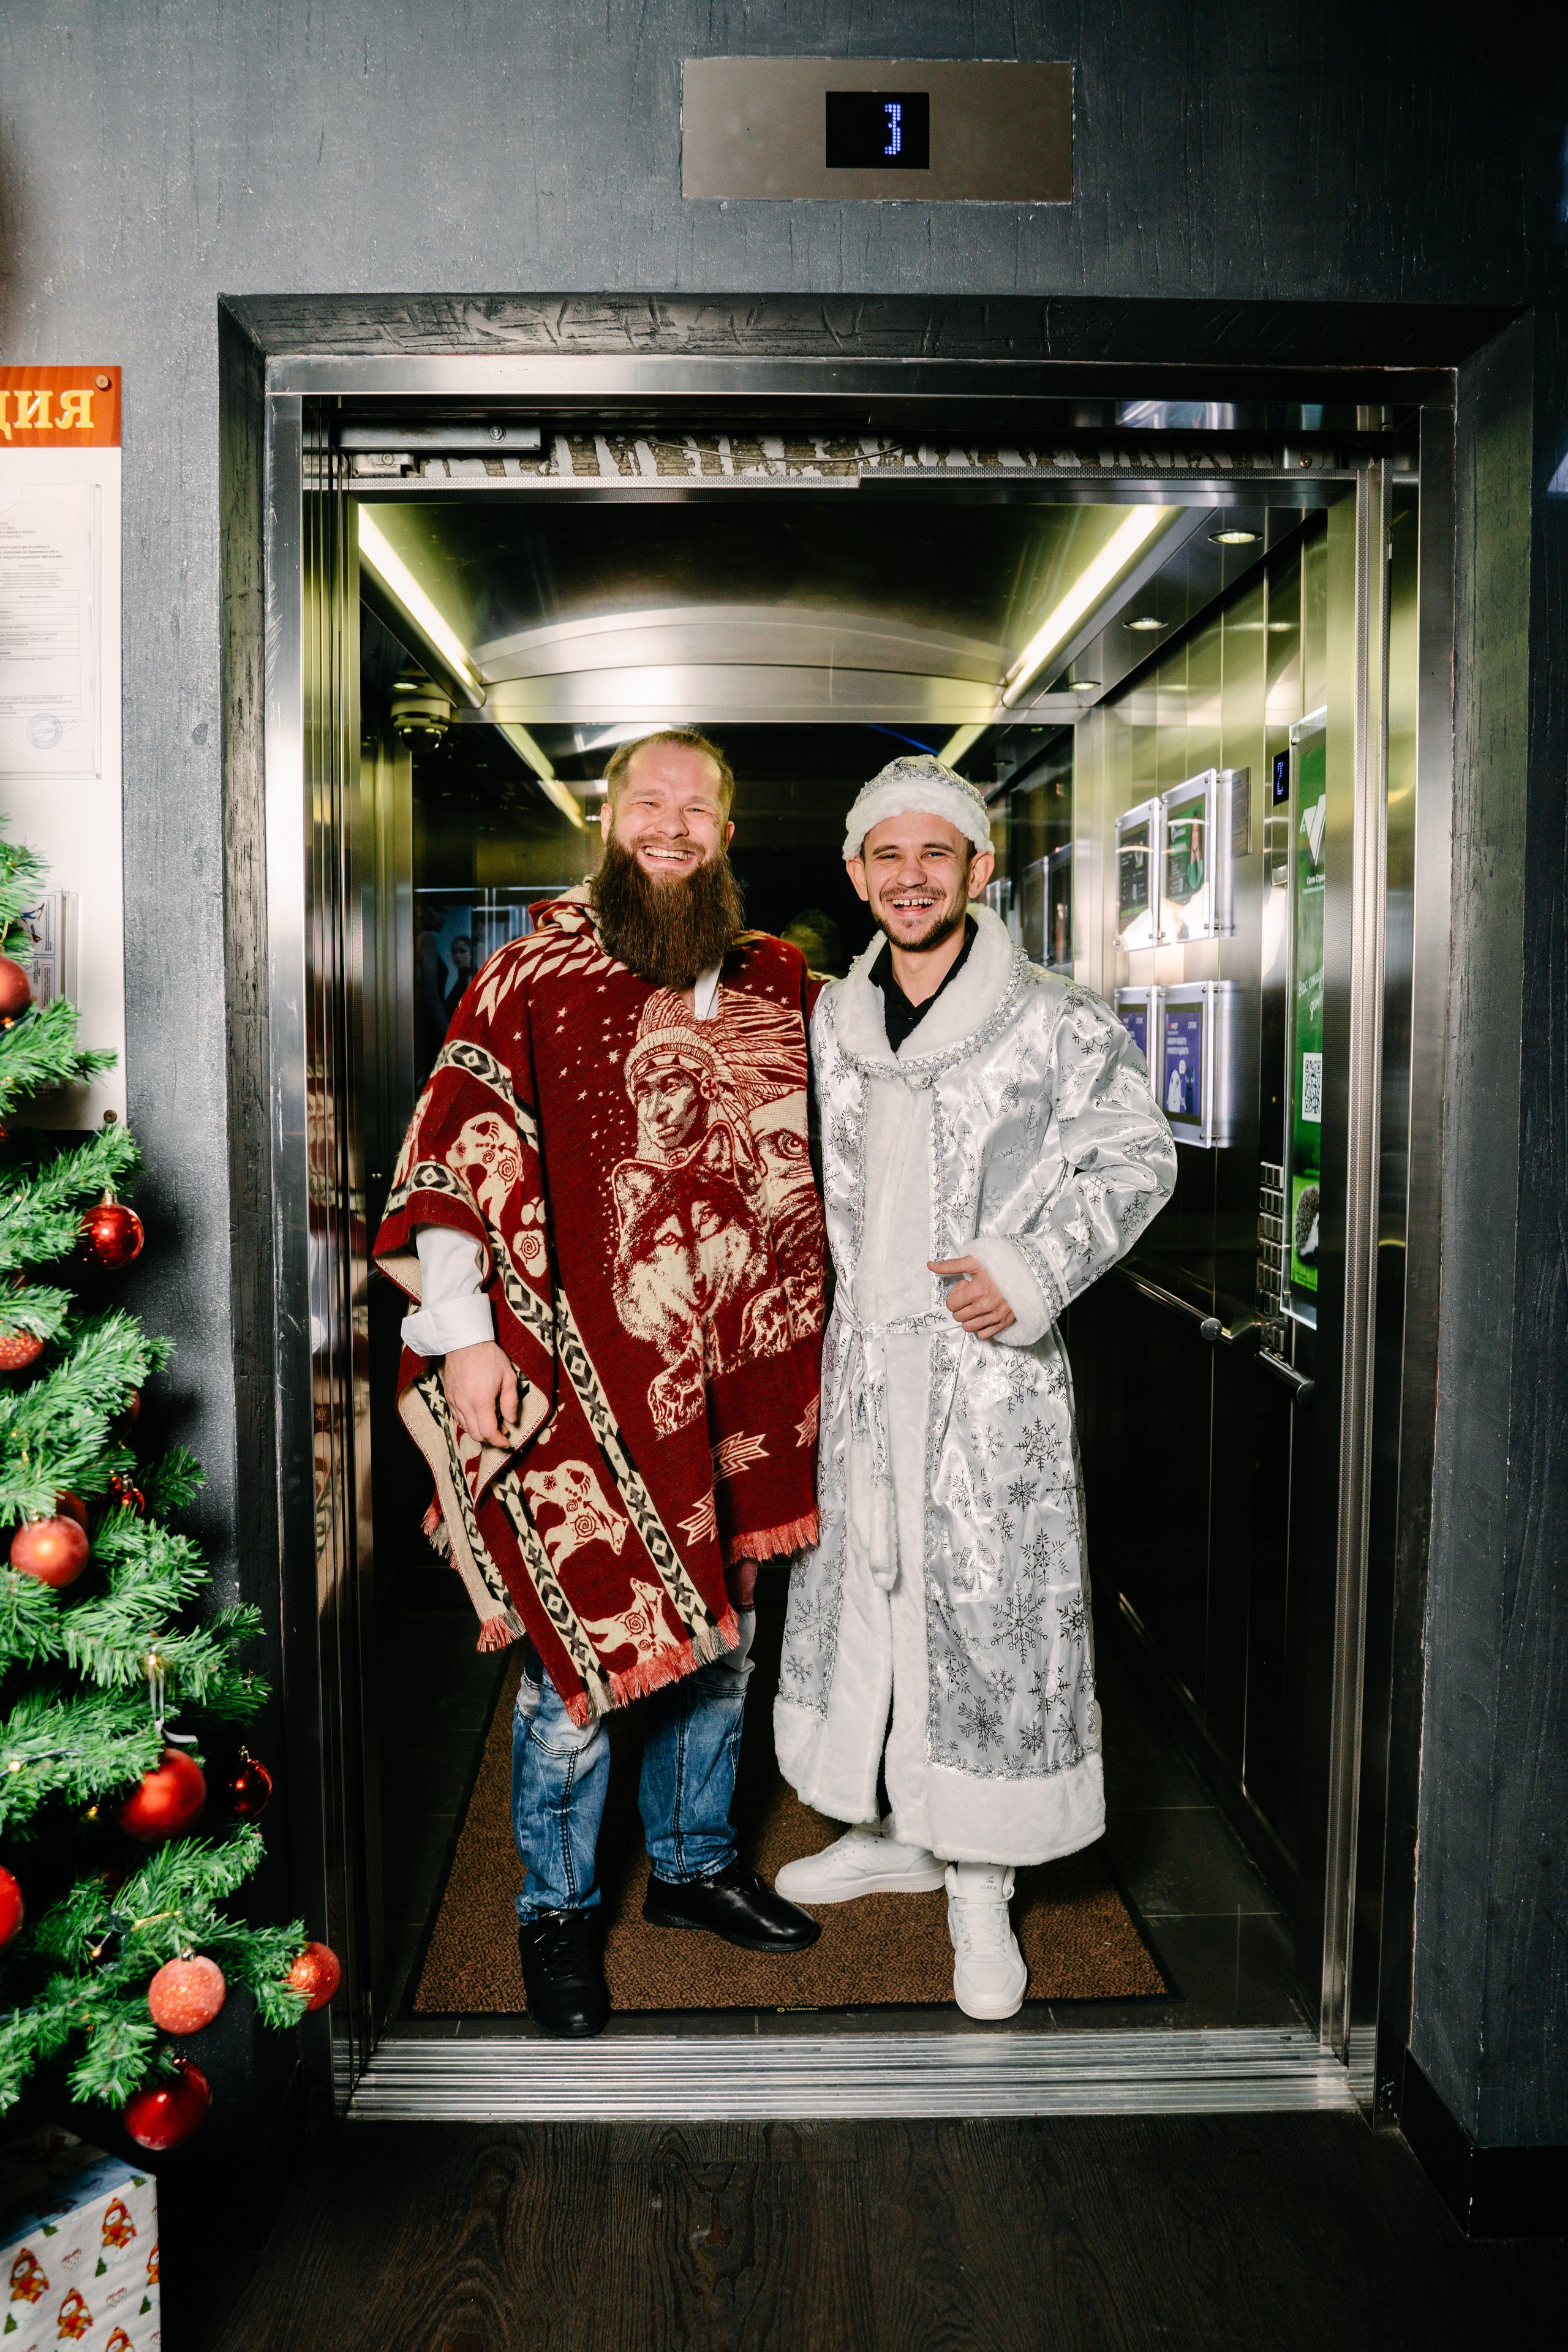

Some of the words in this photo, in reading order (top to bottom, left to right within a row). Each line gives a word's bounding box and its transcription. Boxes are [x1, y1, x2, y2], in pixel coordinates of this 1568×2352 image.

[884, 104, 902, 156] 3
[1276, 762, 1284, 795] 2
[1298, 981, 1308, 998] Вас
